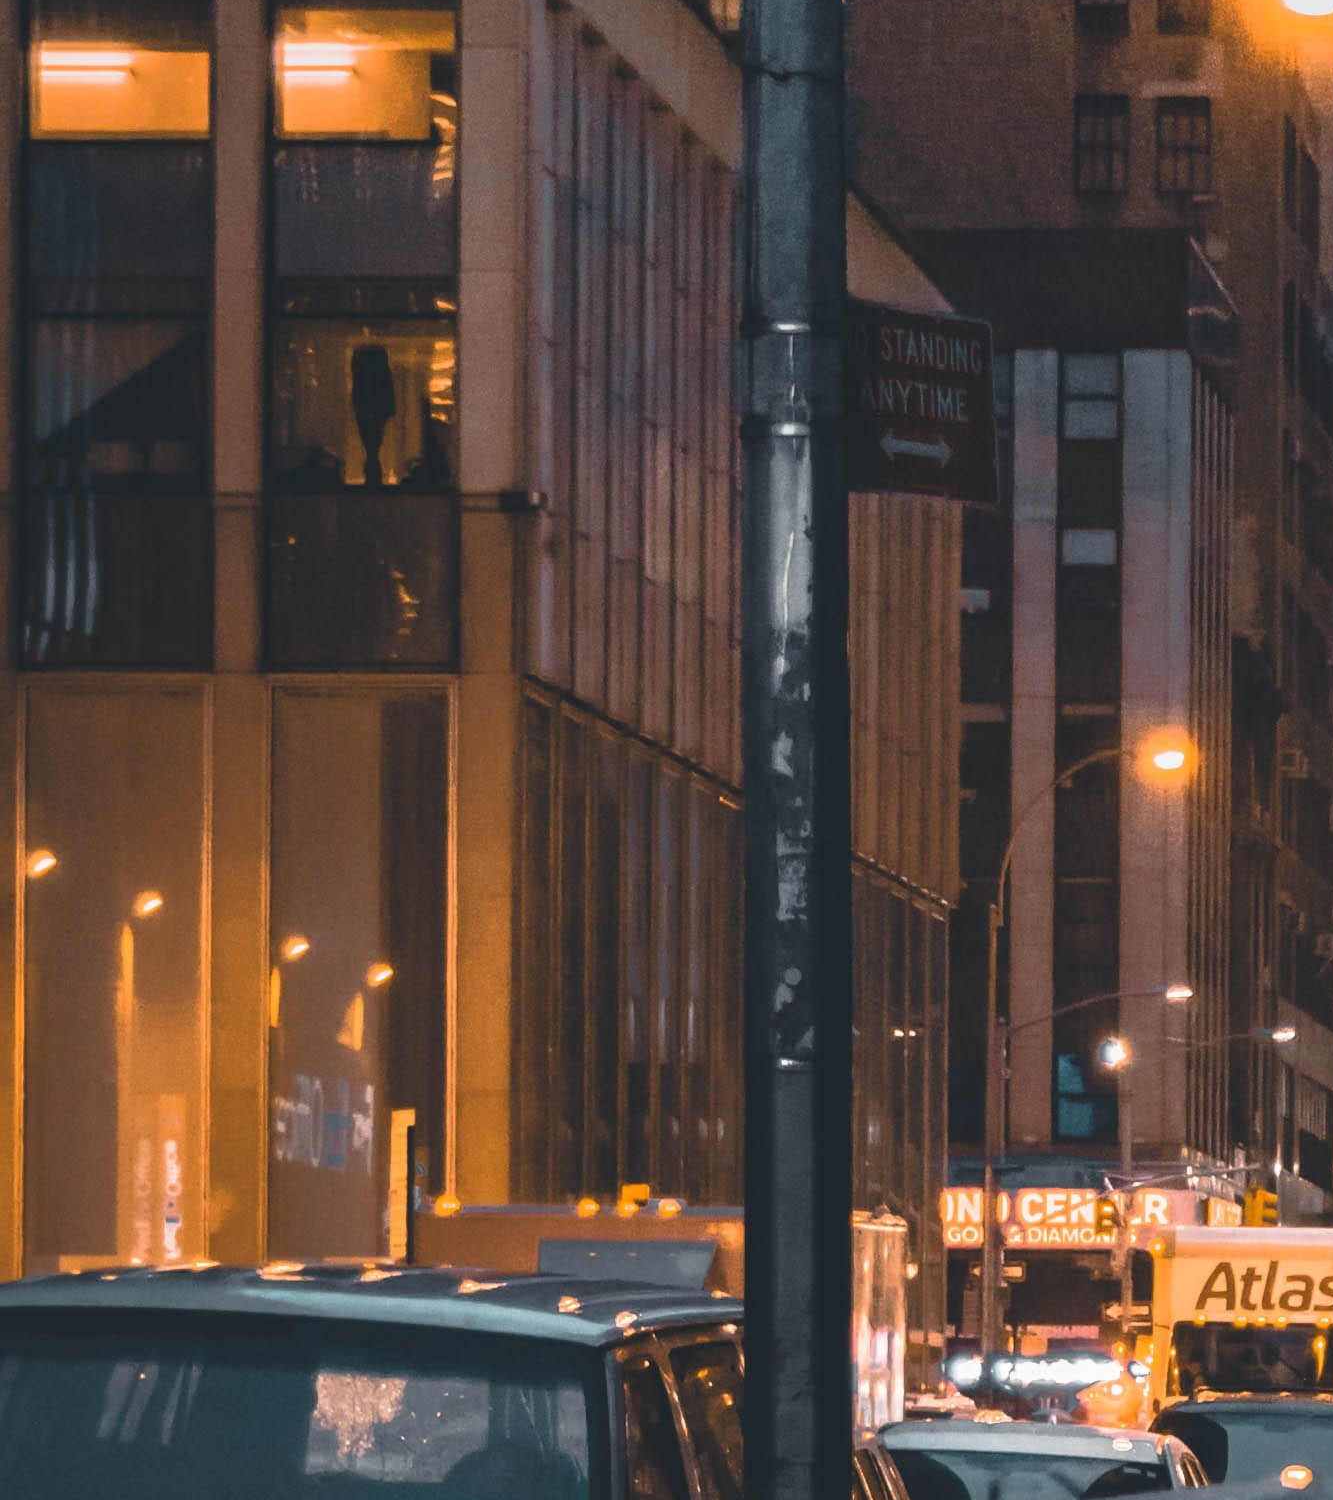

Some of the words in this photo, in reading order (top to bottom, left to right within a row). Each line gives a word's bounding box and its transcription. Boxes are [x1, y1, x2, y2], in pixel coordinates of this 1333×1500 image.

[880, 324, 983, 376] STANDING
[860, 373, 969, 422] ANYTIME
[1021, 1193, 1168, 1225] CENR
